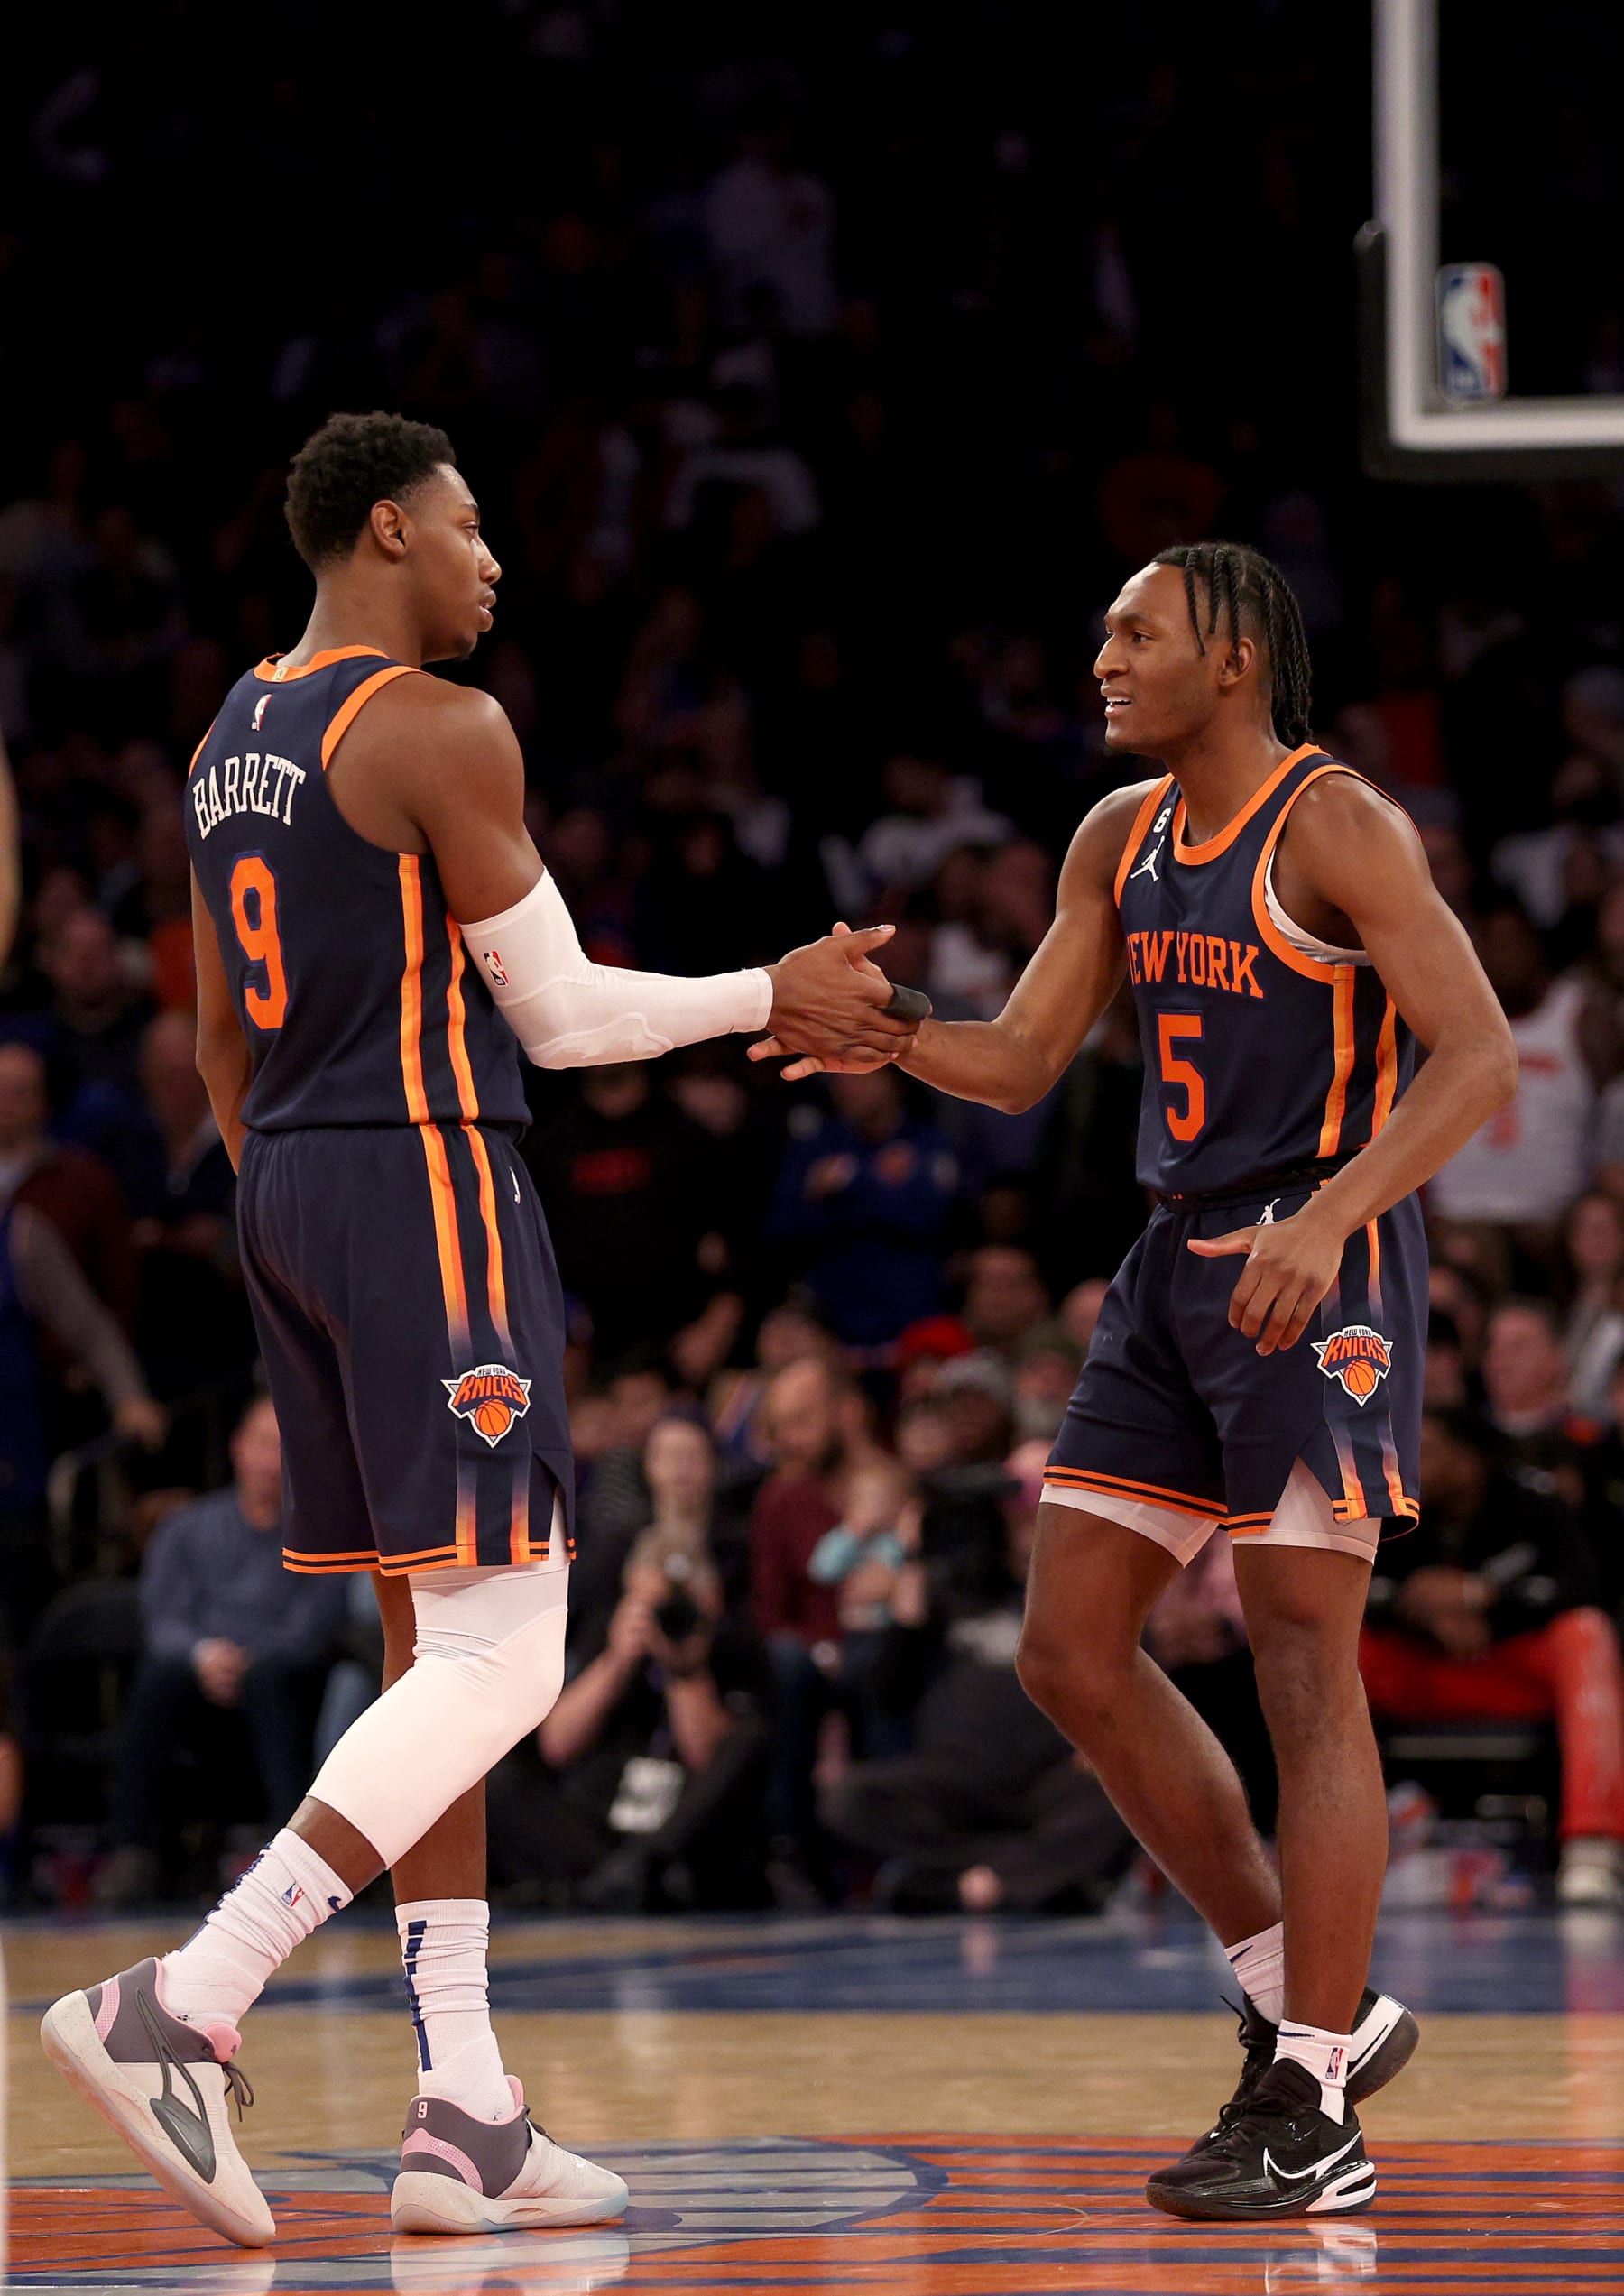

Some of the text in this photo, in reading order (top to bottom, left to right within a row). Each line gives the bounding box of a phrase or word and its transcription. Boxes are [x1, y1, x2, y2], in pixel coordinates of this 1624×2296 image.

[192, 753, 306, 840] BARRETT
[1153, 807, 1172, 833] 6
[229, 850, 288, 1029] 9
[1176, 931, 1263, 999] YORK
[1156, 1010, 1207, 1145] 5
[1322, 1336, 1389, 1367] KNICKS
[452, 1375, 528, 1407] KNICKS
[418, 2101, 428, 2118] 9
